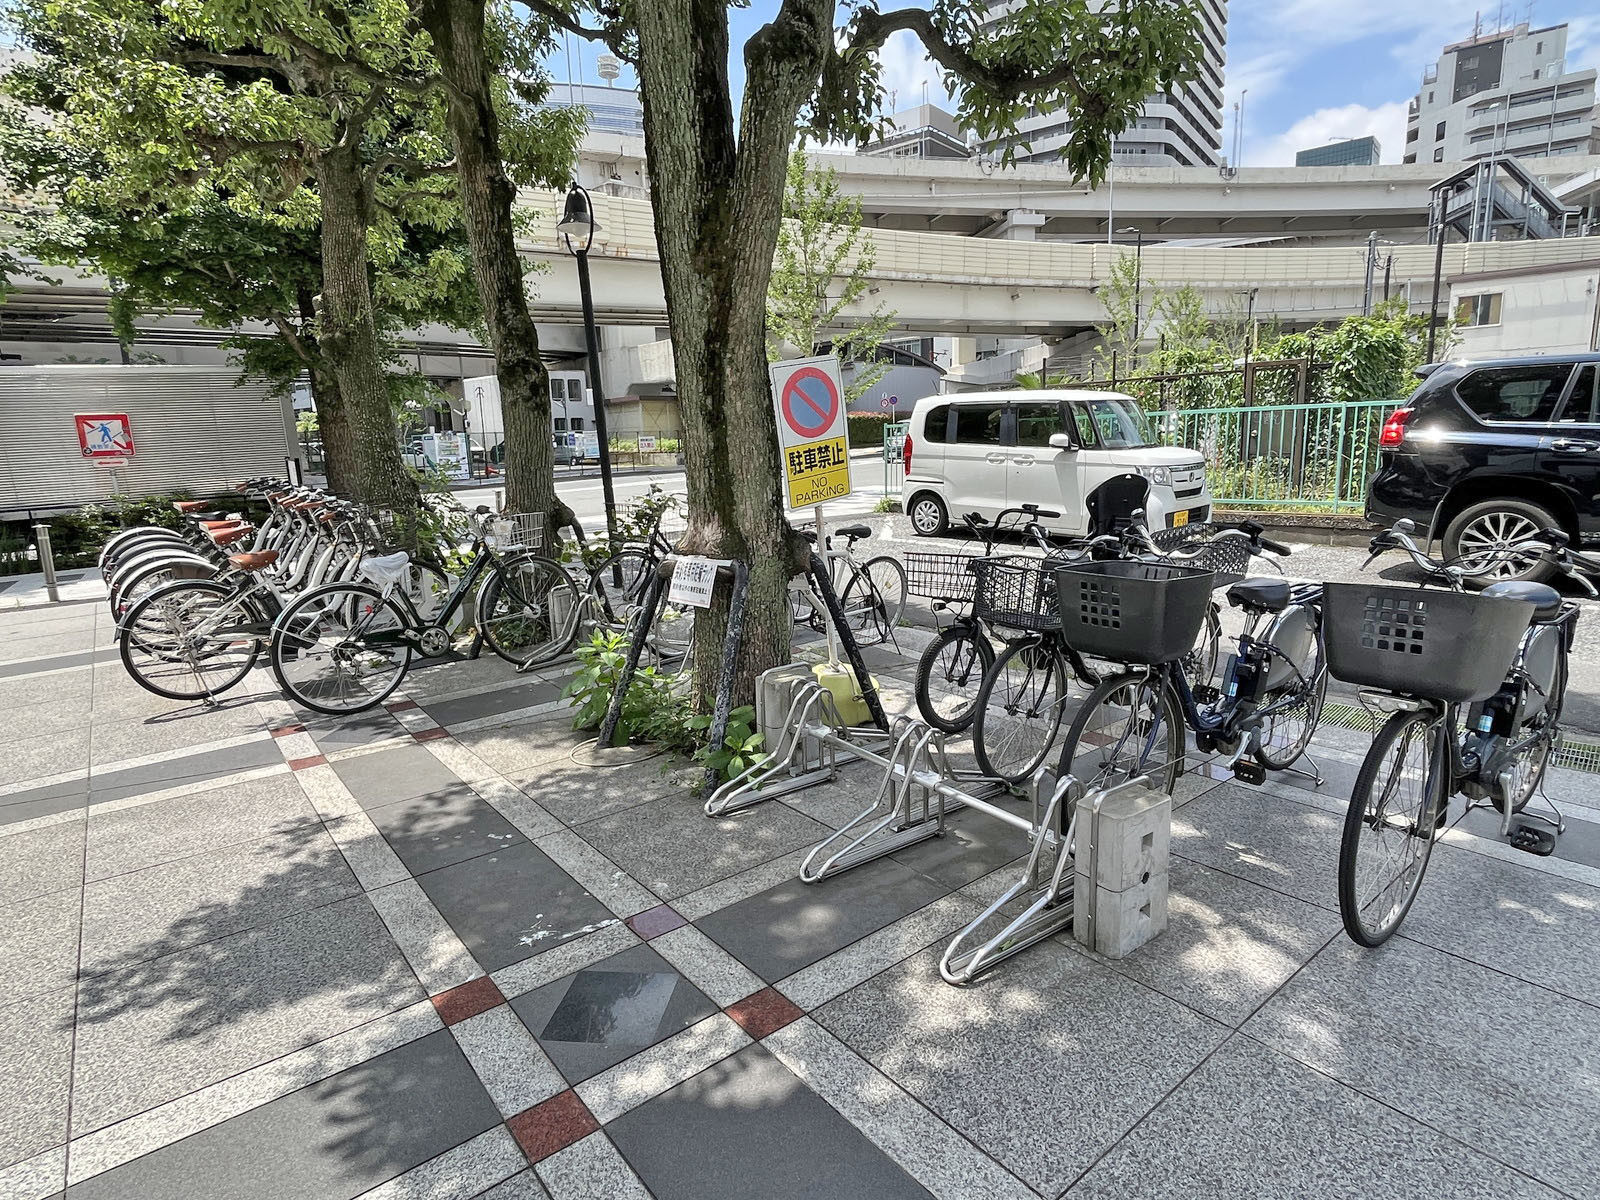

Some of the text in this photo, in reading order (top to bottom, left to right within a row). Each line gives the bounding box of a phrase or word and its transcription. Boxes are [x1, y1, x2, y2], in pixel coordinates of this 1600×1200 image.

[789, 442, 845, 476] 駐車禁止
[811, 476, 828, 489] NO
[796, 483, 845, 505] PARKING
